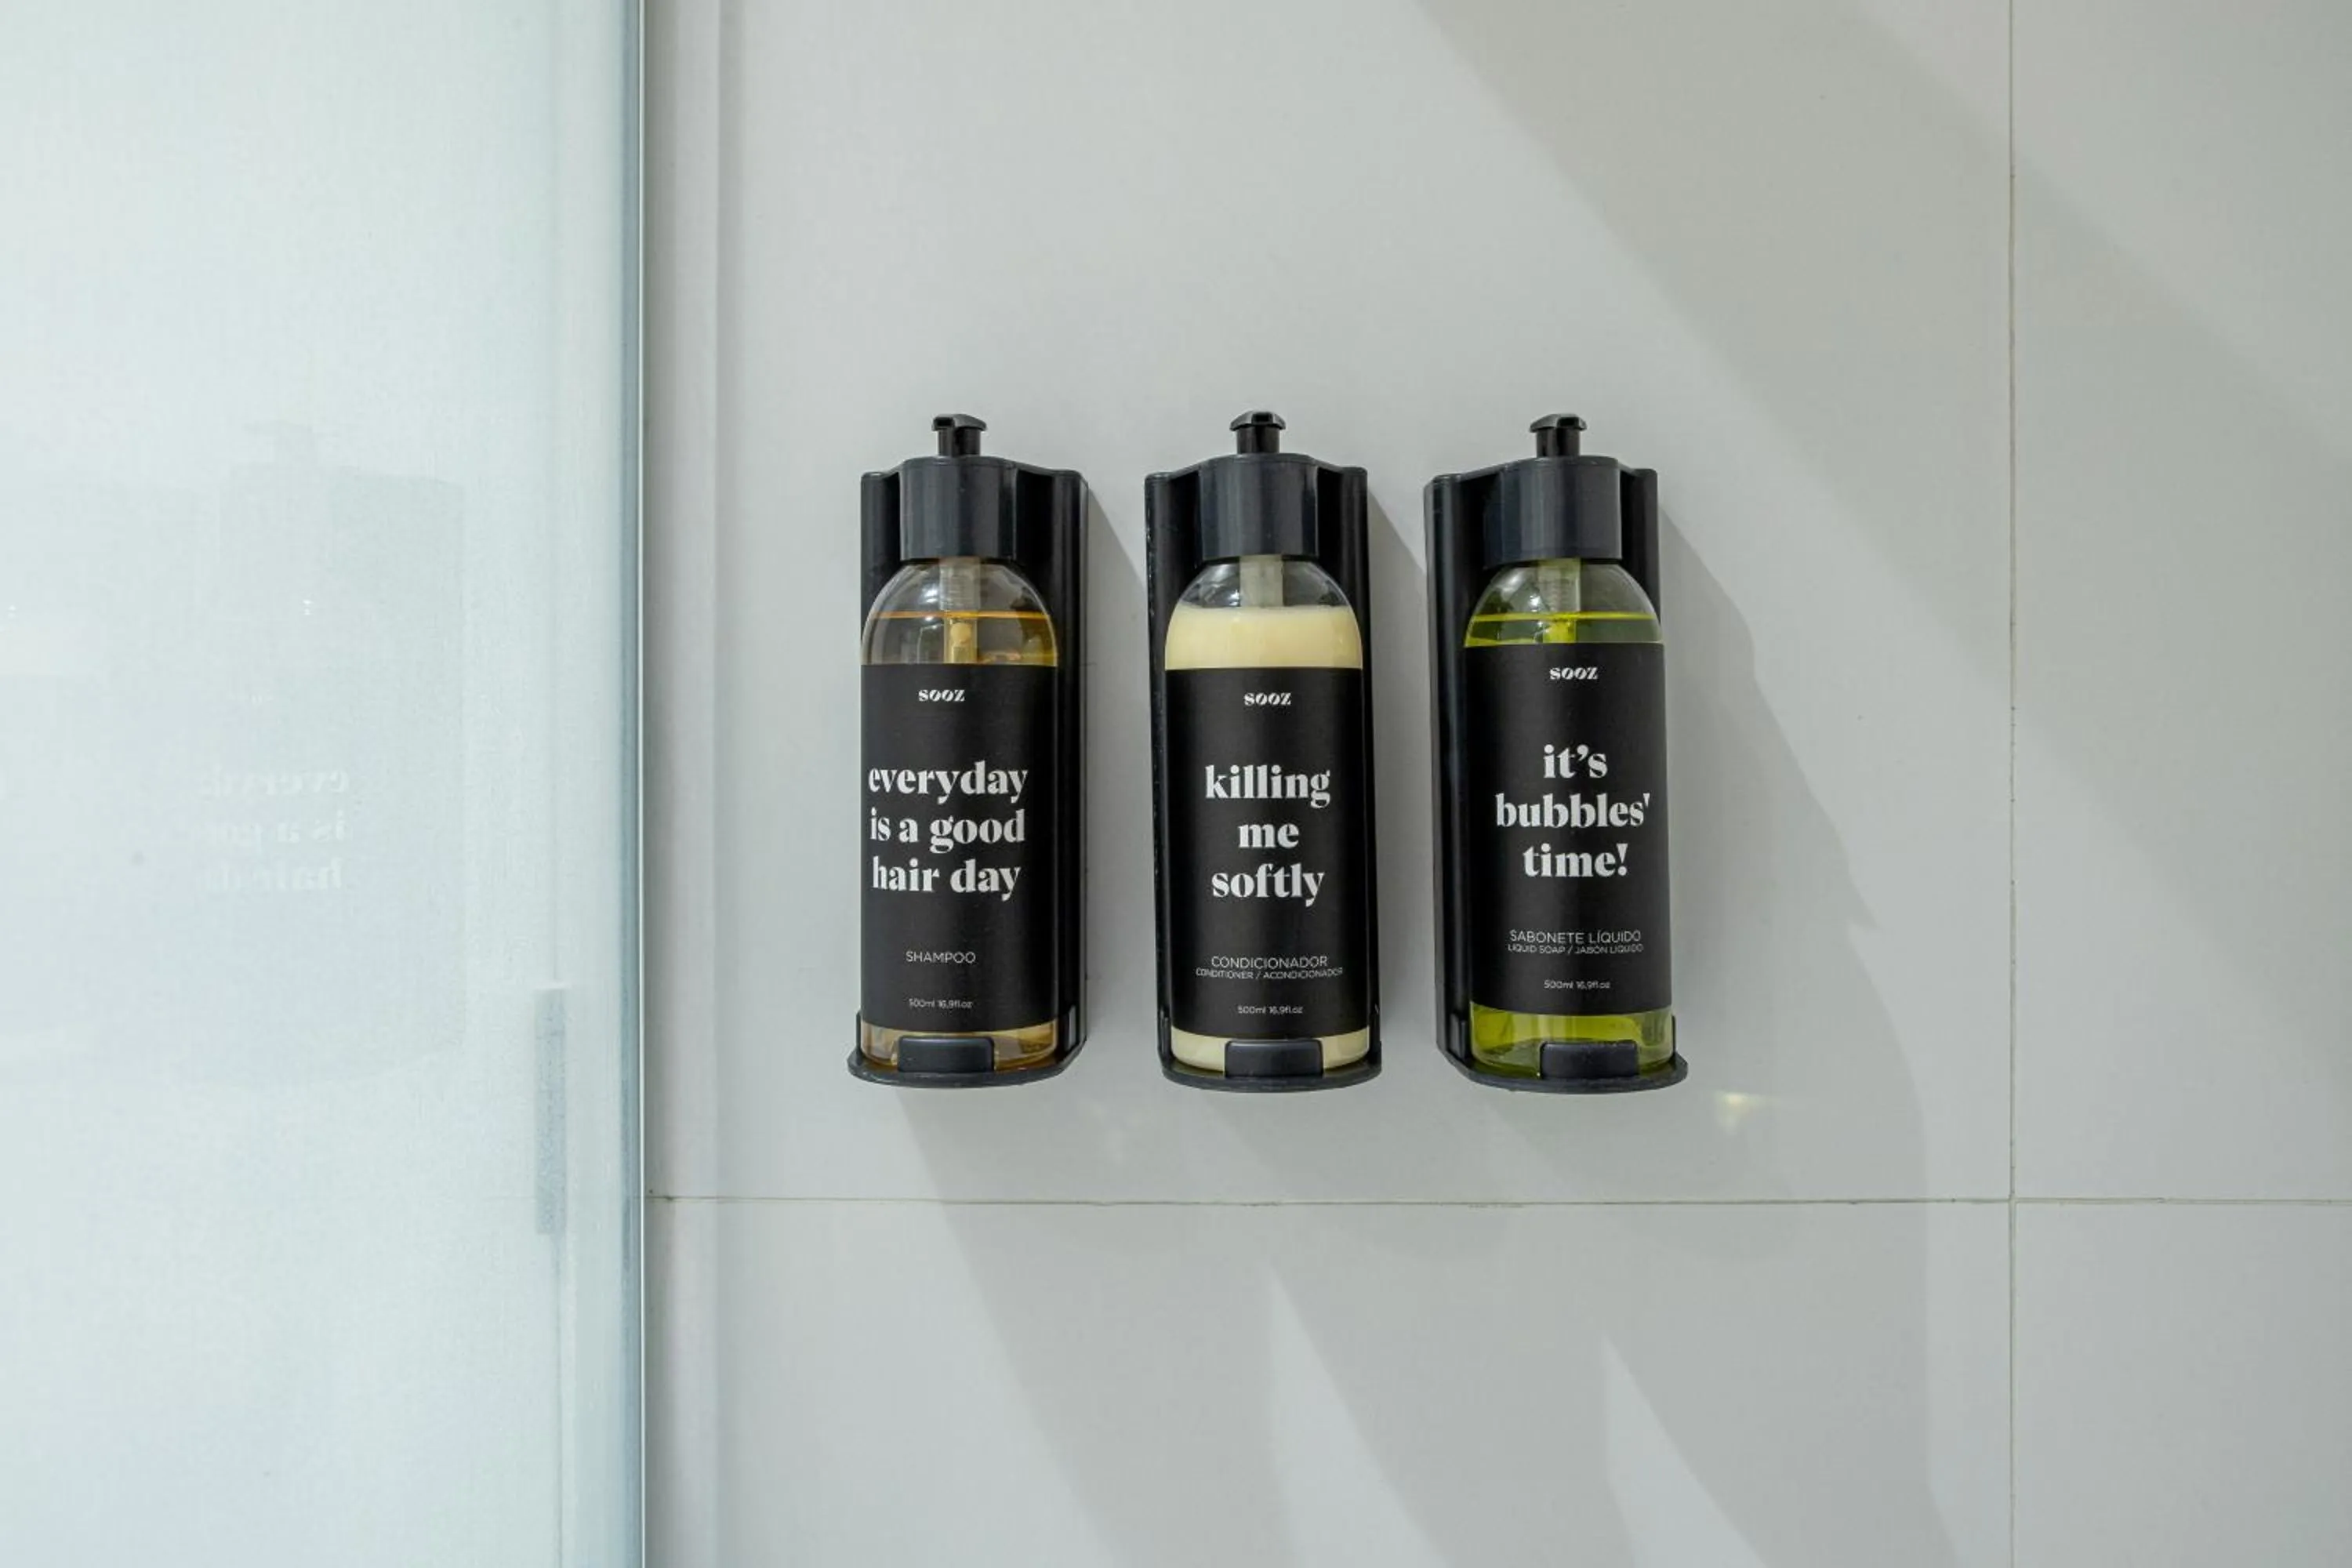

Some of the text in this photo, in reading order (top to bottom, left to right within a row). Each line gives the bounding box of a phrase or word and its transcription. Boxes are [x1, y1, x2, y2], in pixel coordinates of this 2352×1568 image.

[1549, 667, 1597, 680] sooz
[918, 689, 964, 702] sooz
[1243, 693, 1290, 706] sooz
[1543, 744, 1607, 778] it’s
[868, 760, 1027, 804] everyday
[1205, 764, 1330, 808] killing
[1496, 793, 1650, 828] bubbles'
[870, 807, 1024, 854] is a good
[1237, 824, 1299, 848] me
[1523, 843, 1628, 877] time!
[873, 855, 1021, 901] hair day
[1211, 863, 1324, 907] softly
[1508, 929, 1642, 944] SABONETE LÍQUIDO
[1508, 943, 1537, 953] LIQUID
[1539, 945, 1565, 954] SOAP
[906, 950, 976, 964] SHAMPOO
[1211, 955, 1327, 969] CONDICIONADOR
[1196, 967, 1254, 980] CONDITIONER
[1263, 967, 1343, 979] ACONDICIONADOR
[1544, 980, 1573, 989] 500ml
[909, 997, 935, 1008] 500ml
[1237, 1005, 1266, 1014] 500ml
